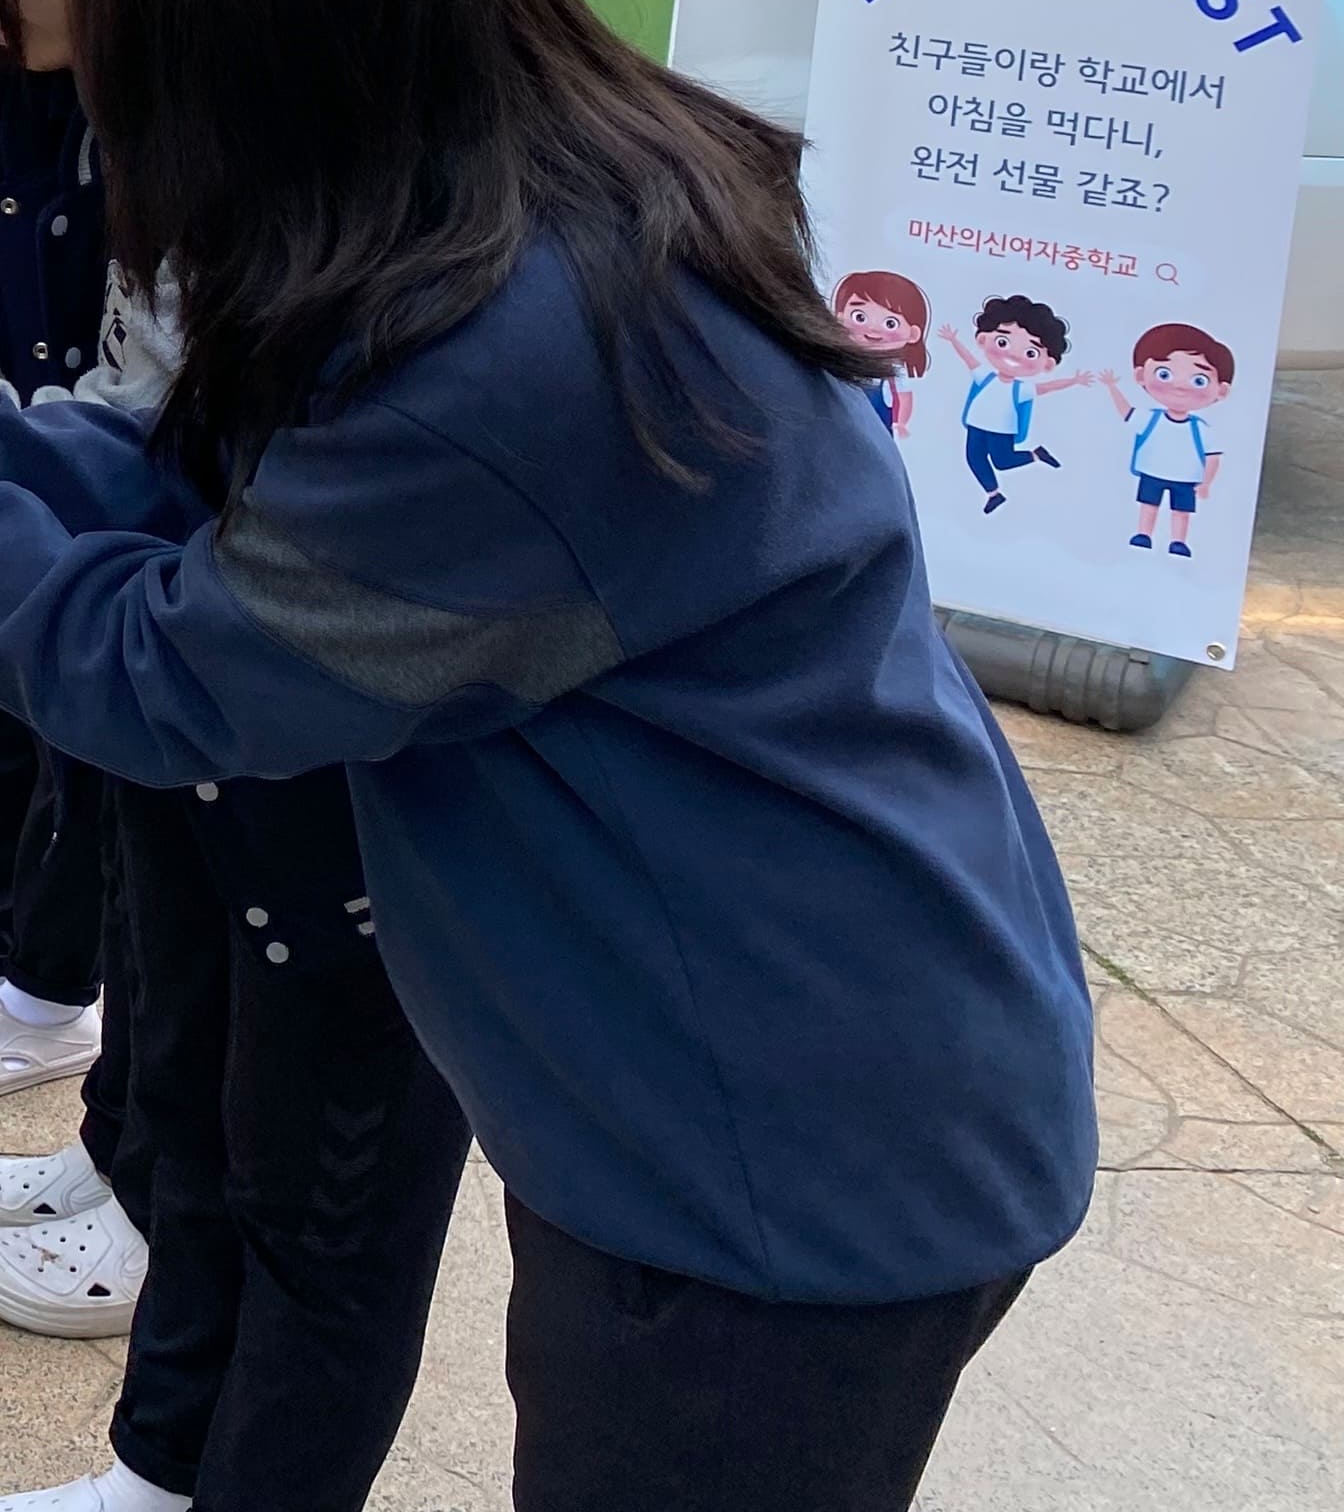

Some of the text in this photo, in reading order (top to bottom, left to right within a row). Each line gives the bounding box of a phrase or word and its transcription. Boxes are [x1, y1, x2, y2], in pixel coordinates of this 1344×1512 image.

[888, 31, 1225, 110] 친구들이랑 학교에서
[928, 94, 1164, 160] 아침을 먹다니,
[910, 145, 1171, 214] 완전 선물 같죠?
[908, 219, 1139, 279] 마산의신여자중학교
